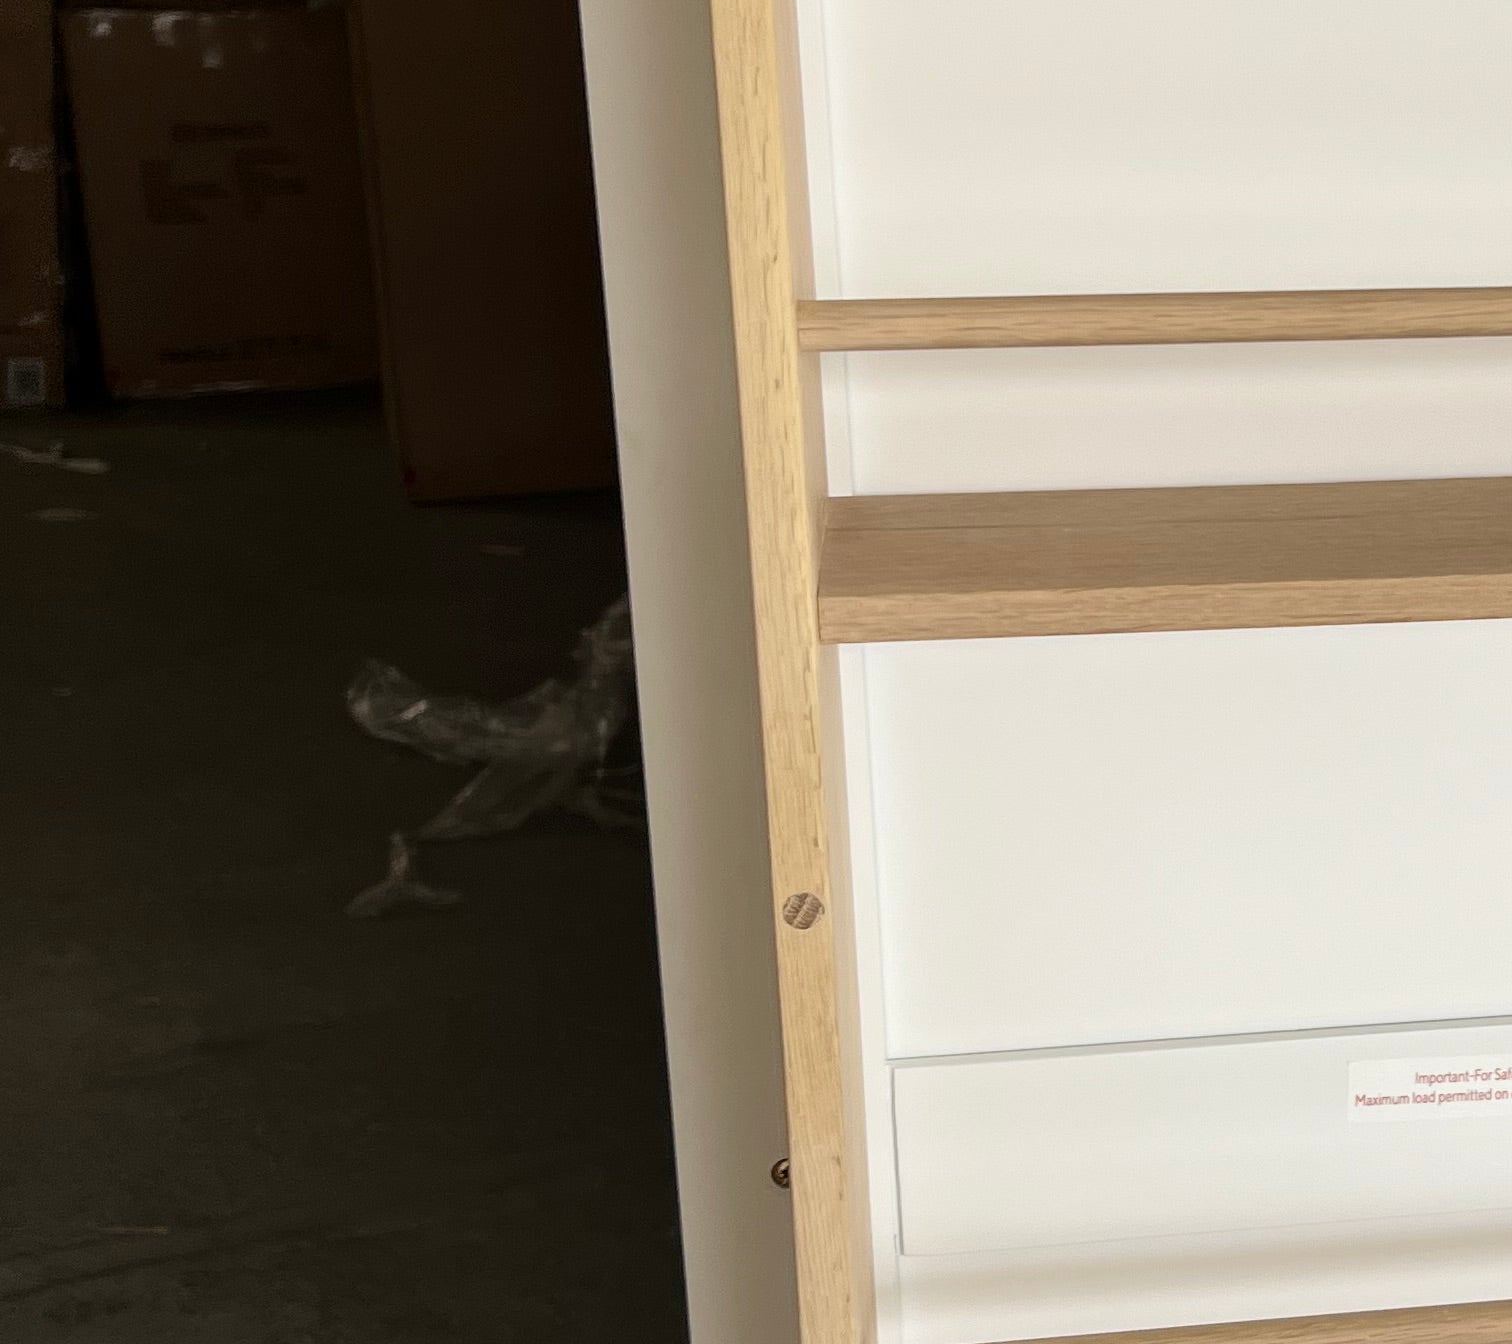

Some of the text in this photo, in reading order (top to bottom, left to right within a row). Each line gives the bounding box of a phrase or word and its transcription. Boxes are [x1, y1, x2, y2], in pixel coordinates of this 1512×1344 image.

[1415, 1068, 1492, 1086] Important-For
[1354, 1094, 1410, 1106] Maximum
[1412, 1091, 1436, 1104] load
[1438, 1089, 1492, 1106] permitted
[1495, 1090, 1509, 1100] on
